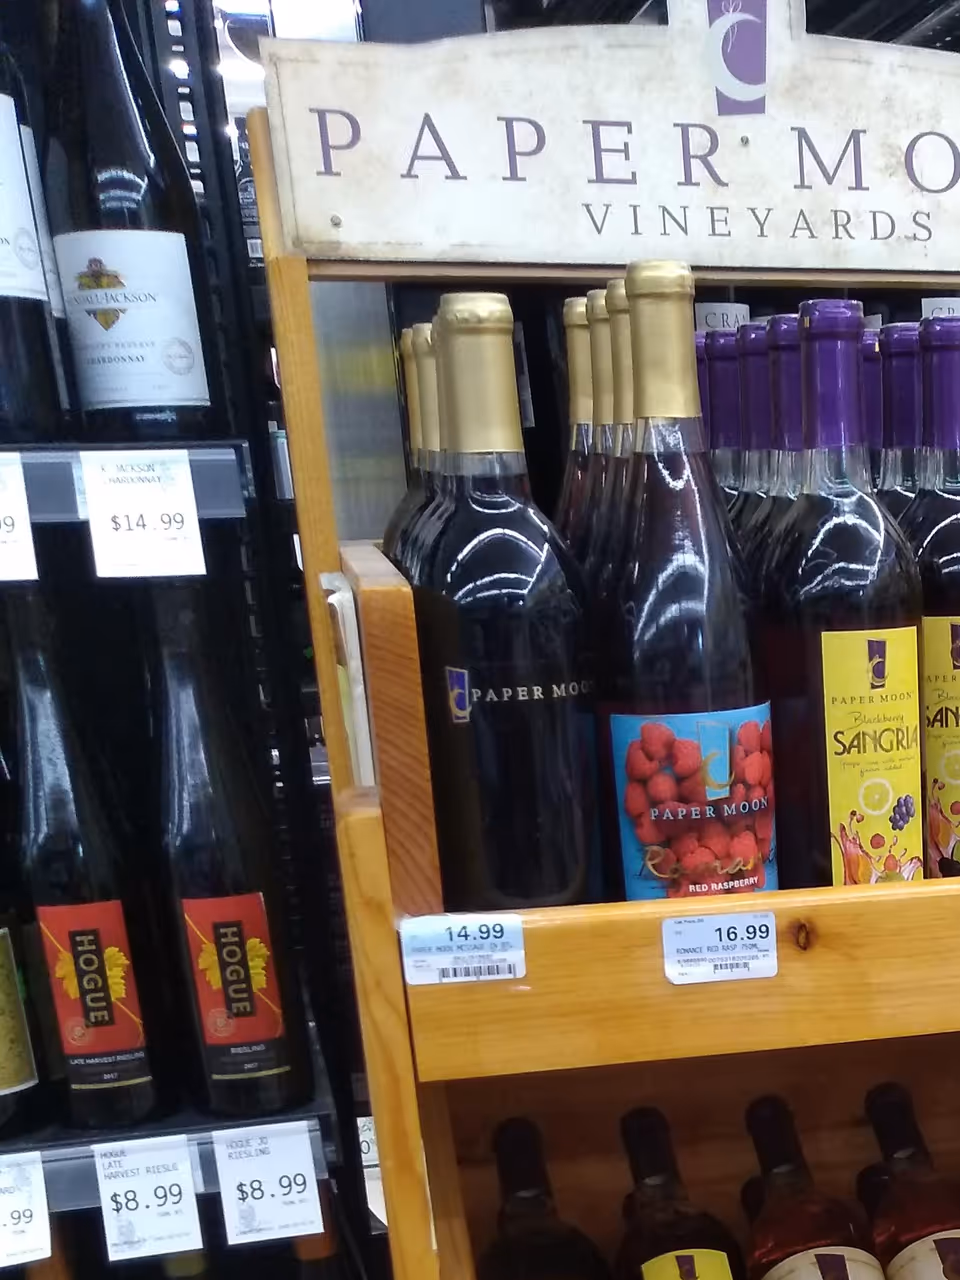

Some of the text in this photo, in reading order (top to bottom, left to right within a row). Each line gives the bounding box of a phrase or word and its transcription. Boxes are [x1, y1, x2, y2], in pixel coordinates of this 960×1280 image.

[309, 107, 729, 188] PAPER
[582, 203, 933, 242] VINEYARDS
[111, 512, 186, 532] $14.99
[472, 685, 545, 703] PAPER
[831, 692, 914, 705] PAPER MOON
[847, 711, 905, 730] Blackberry
[833, 725, 918, 757] SANGRIA
[650, 796, 770, 821] PAPER MOON
[689, 876, 759, 892] RED RASPBERRY
[445, 923, 505, 941] 14.99
[714, 923, 770, 942] 16.99
[73, 934, 111, 1025] HOGUE
[218, 926, 253, 1015] HOGUE
[86, 1055, 116, 1064] HARVEST
[100, 1149, 127, 1159] HOGUE
[226, 1140, 254, 1151] HOGUE
[227, 1148, 271, 1161] RIESLING
[102, 1160, 123, 1170] LATE
[104, 1168, 140, 1181] HARVEST
[236, 1172, 307, 1203] $8.99
[110, 1182, 183, 1214] $8.99
